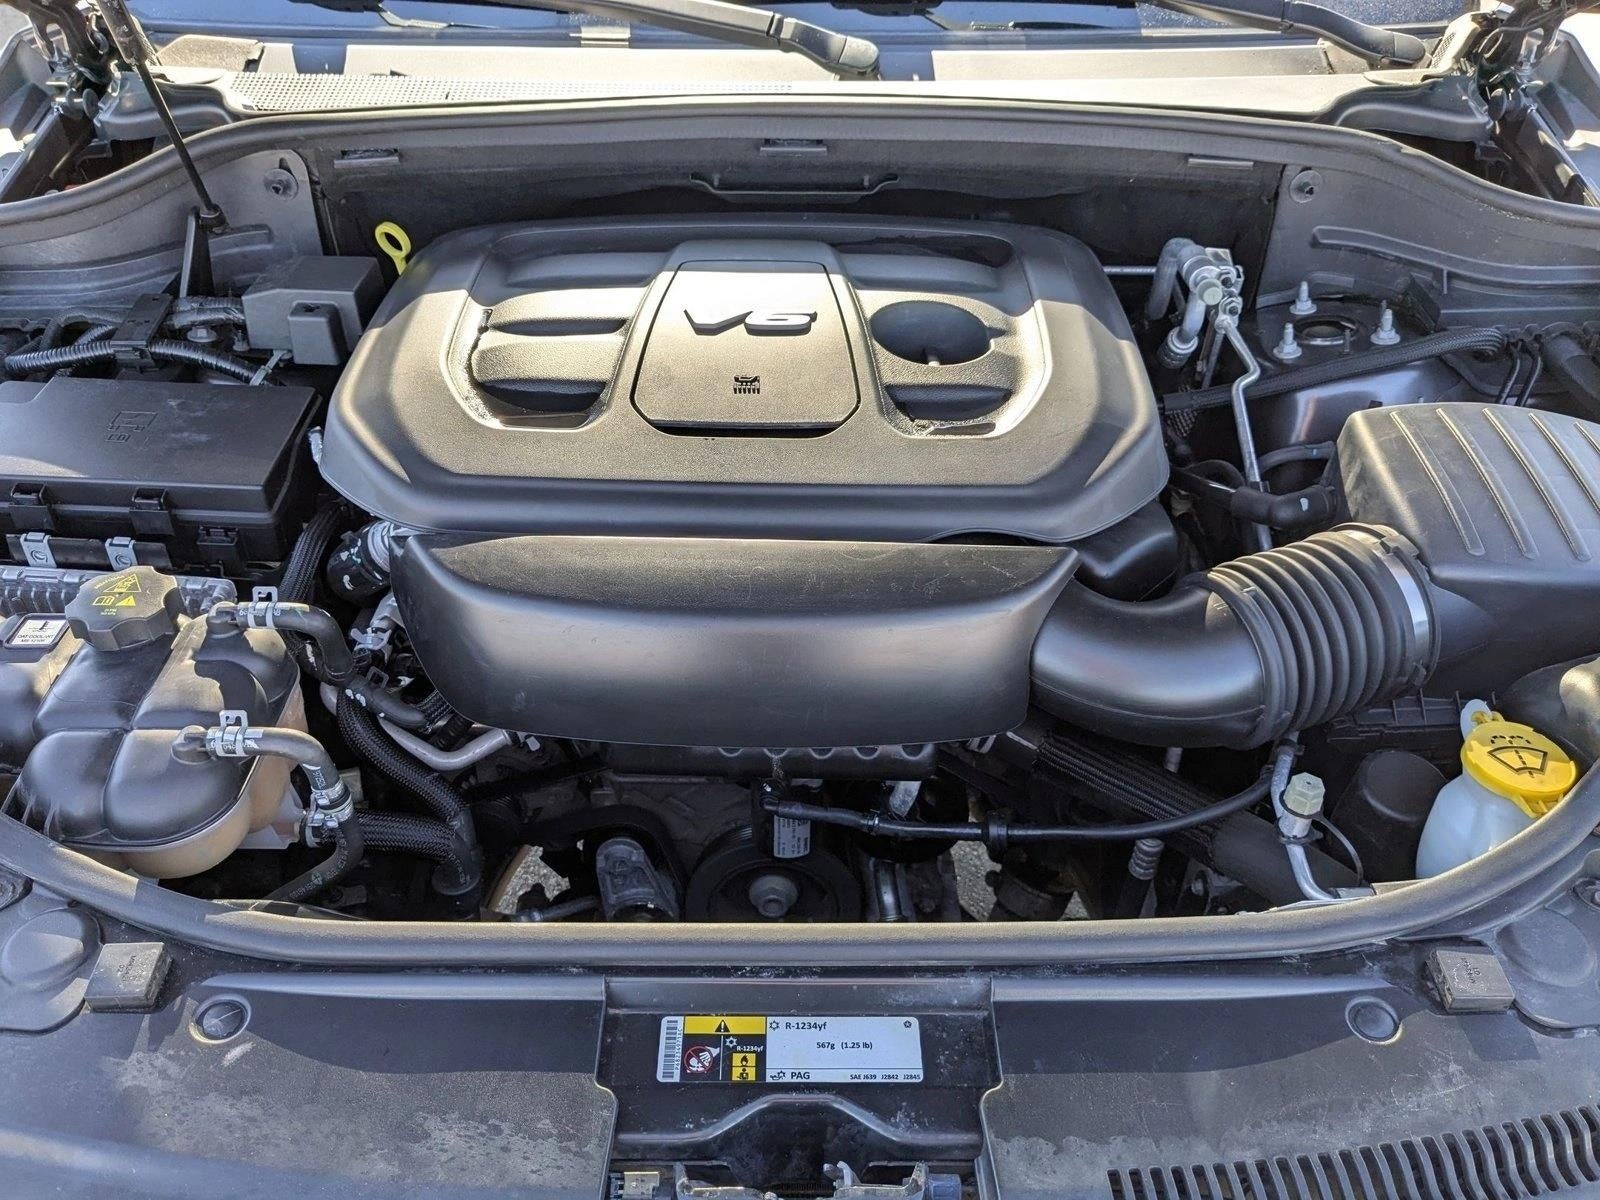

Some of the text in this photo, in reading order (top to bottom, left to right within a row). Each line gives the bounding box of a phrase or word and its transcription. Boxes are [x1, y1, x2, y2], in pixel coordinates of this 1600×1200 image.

[683, 307, 819, 337] V6
[785, 1021, 827, 1032] R-1234yf
[736, 1045, 764, 1053] R-1234yf
[816, 1041, 873, 1050] 567g (1.25 lb)
[790, 1071, 811, 1080] PAG
